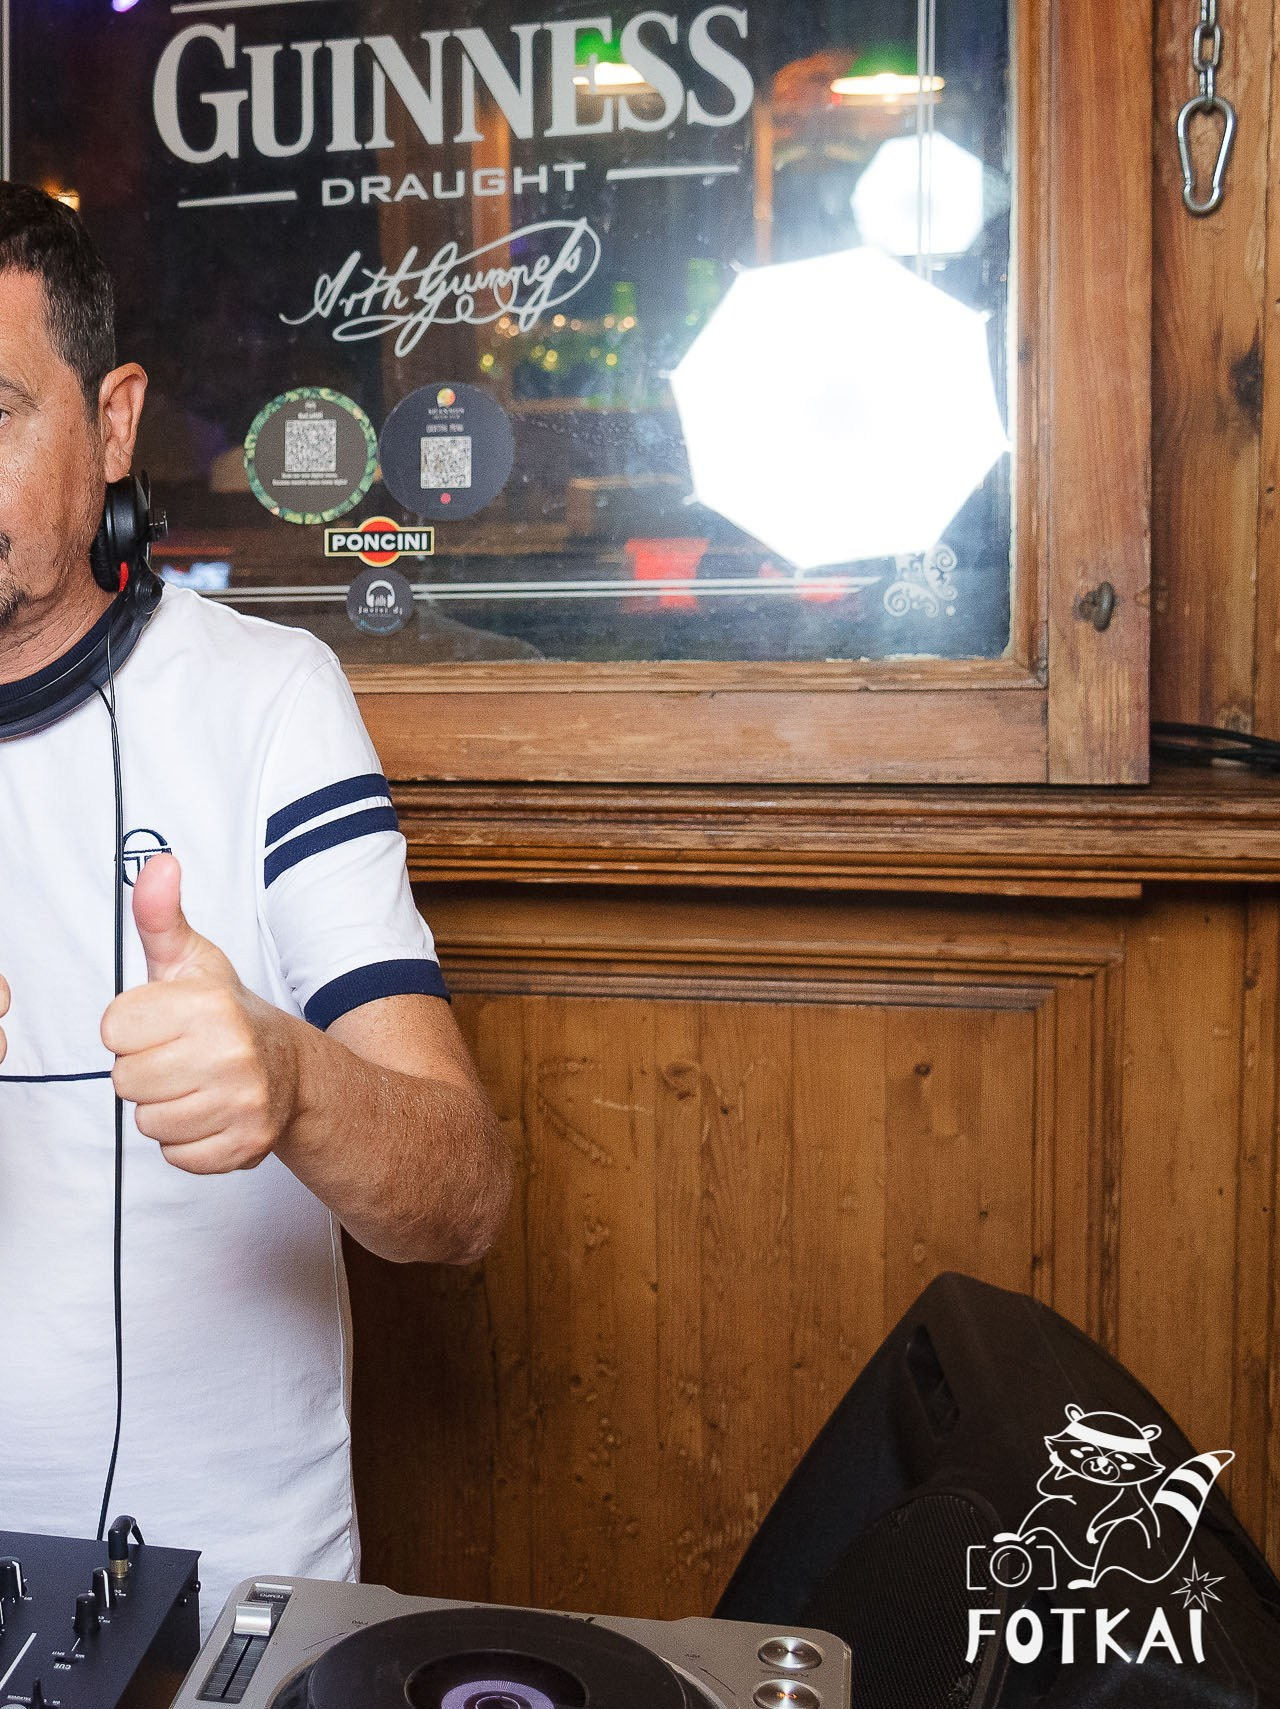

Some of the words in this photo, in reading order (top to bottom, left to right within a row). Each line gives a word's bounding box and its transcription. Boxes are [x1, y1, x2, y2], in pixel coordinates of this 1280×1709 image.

[153, 5, 754, 164] GUINNESS
[321, 162, 587, 206] DRAUGHT
[332, 533, 428, 551] PONCINI
[53, 1662, 72, 1670] CUE
